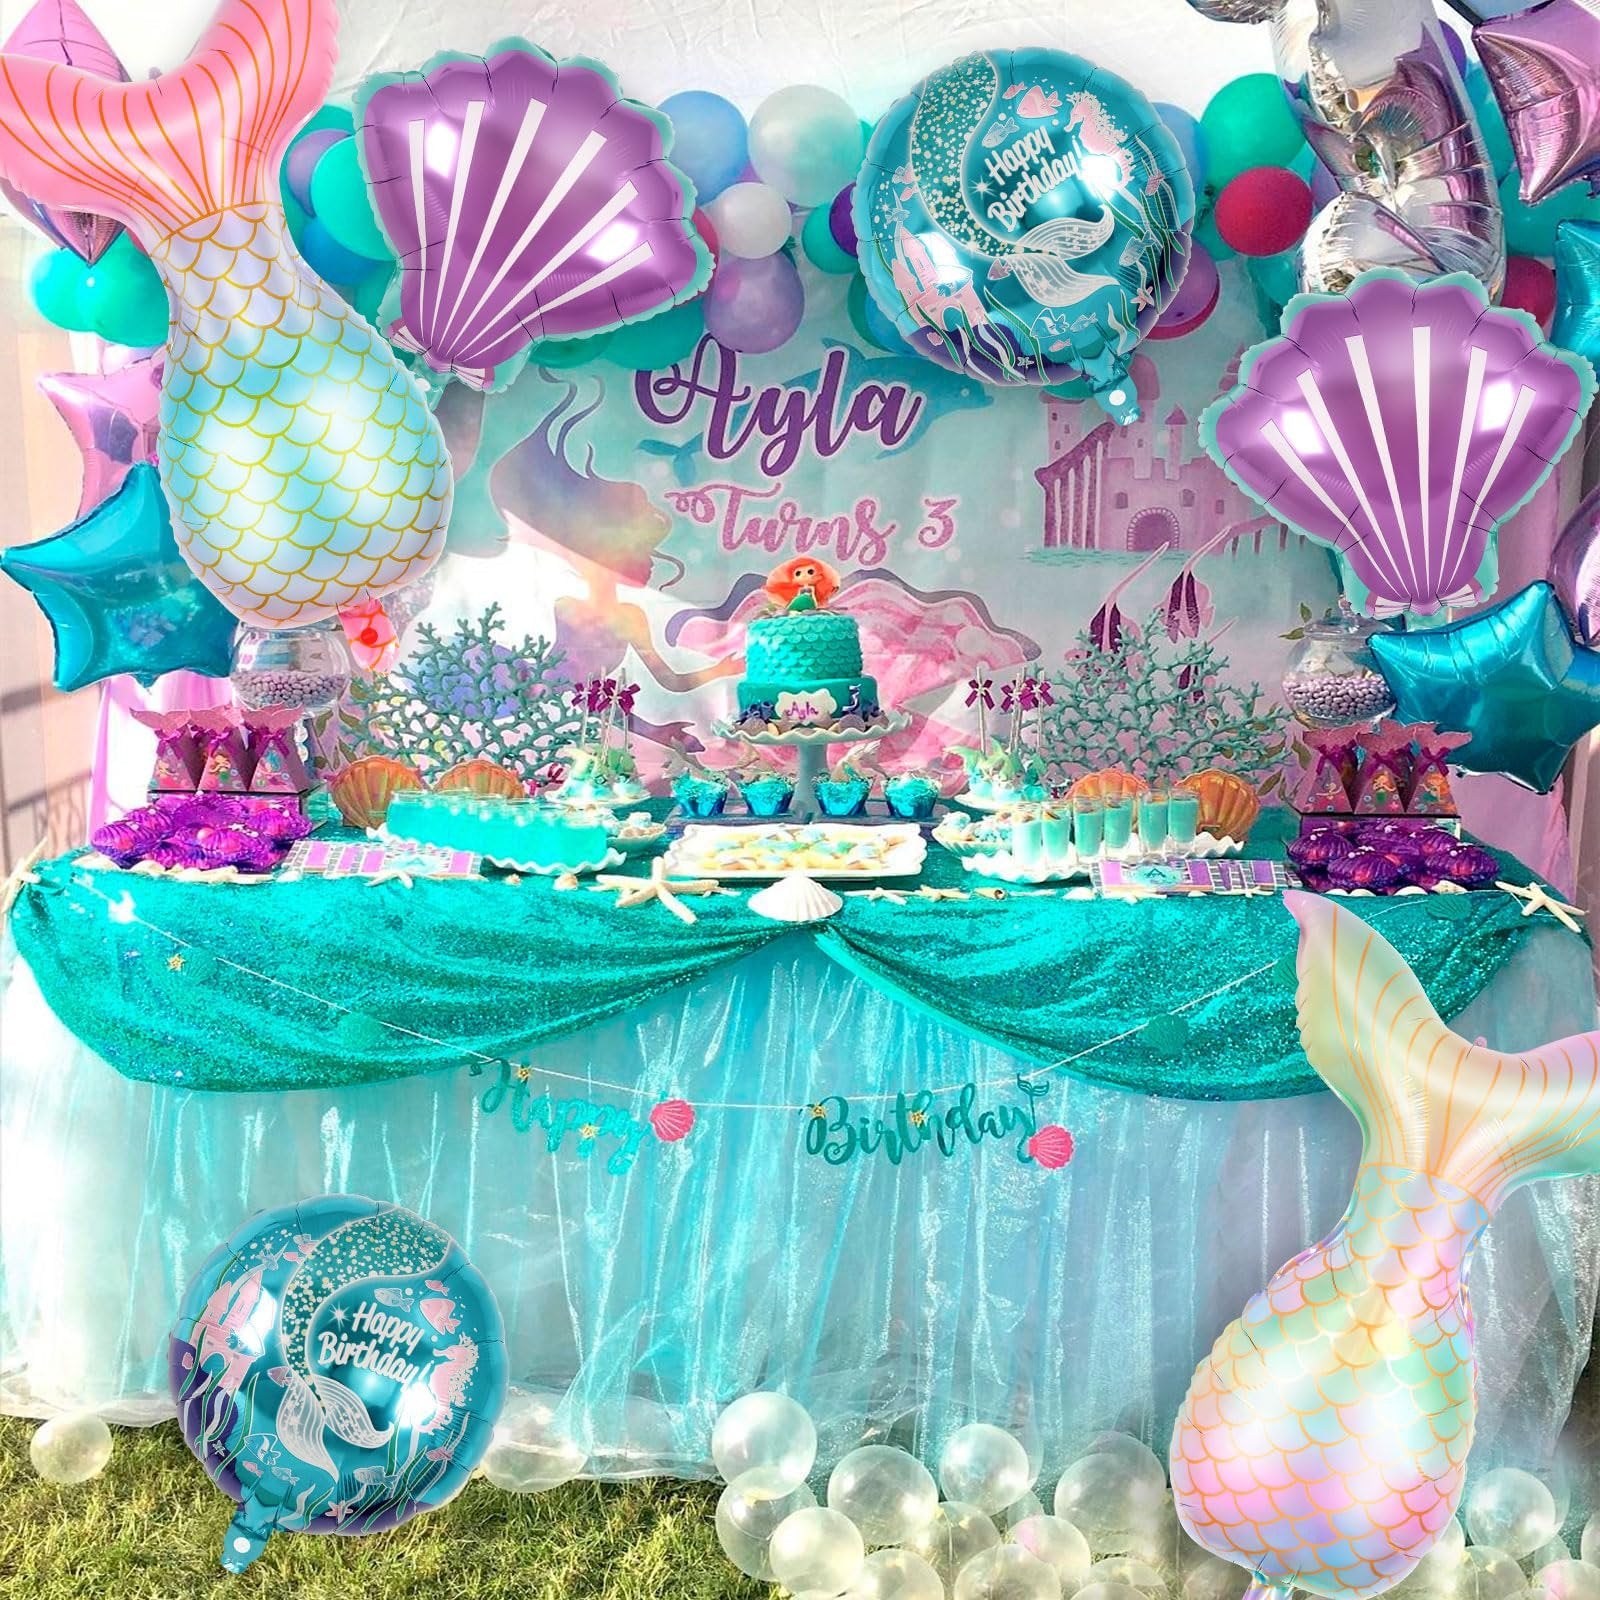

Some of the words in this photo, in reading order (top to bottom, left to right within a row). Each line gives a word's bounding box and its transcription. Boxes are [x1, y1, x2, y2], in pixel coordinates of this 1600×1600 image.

[984, 126, 1055, 185] Happy
[987, 136, 1083, 232] Birthday!
[634, 332, 922, 477] Ayla
[664, 482, 896, 566] Turns
[918, 499, 957, 548] 3
[469, 1058, 651, 1176] Happy
[799, 1080, 1042, 1165] Birthday
[318, 1331, 432, 1392] Birthday!
[352, 1301, 424, 1356] Happy
